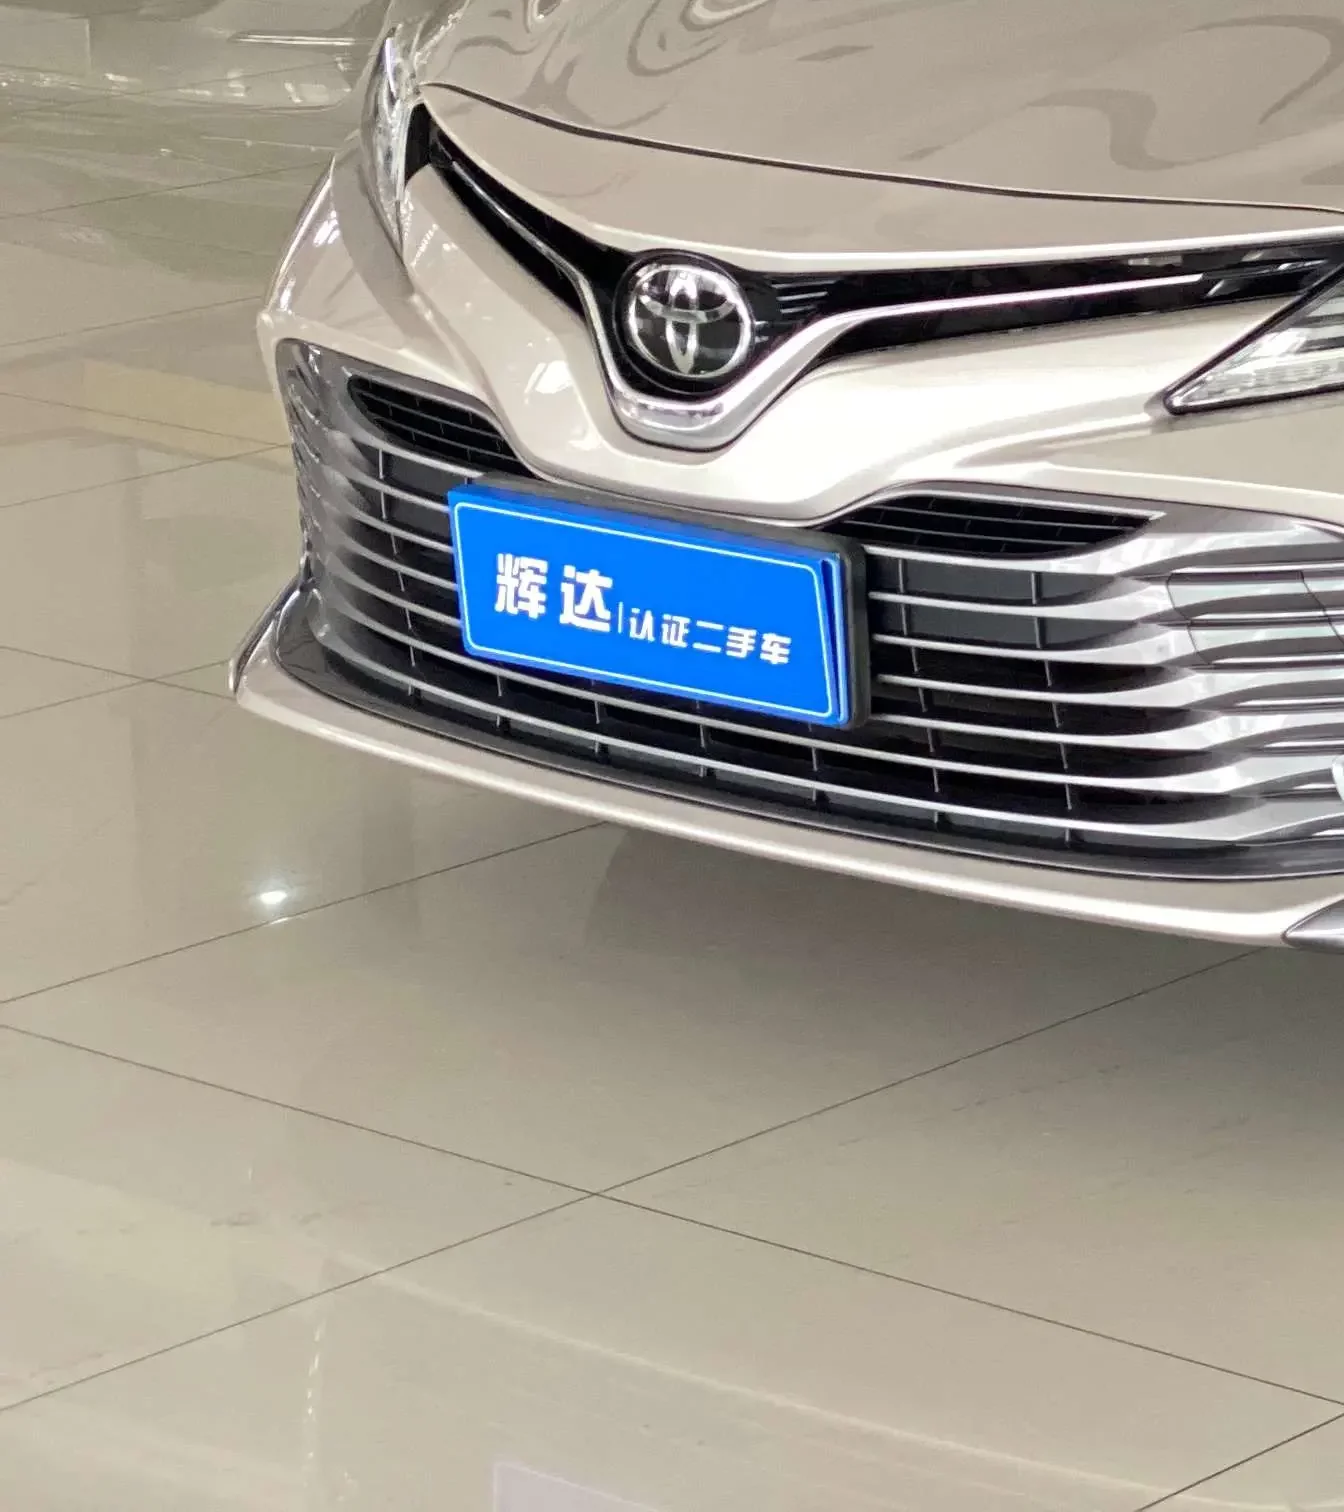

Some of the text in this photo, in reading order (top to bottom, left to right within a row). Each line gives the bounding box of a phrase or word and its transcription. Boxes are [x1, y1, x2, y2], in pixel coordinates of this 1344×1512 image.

[494, 553, 792, 665] 辉达 认证二手车
